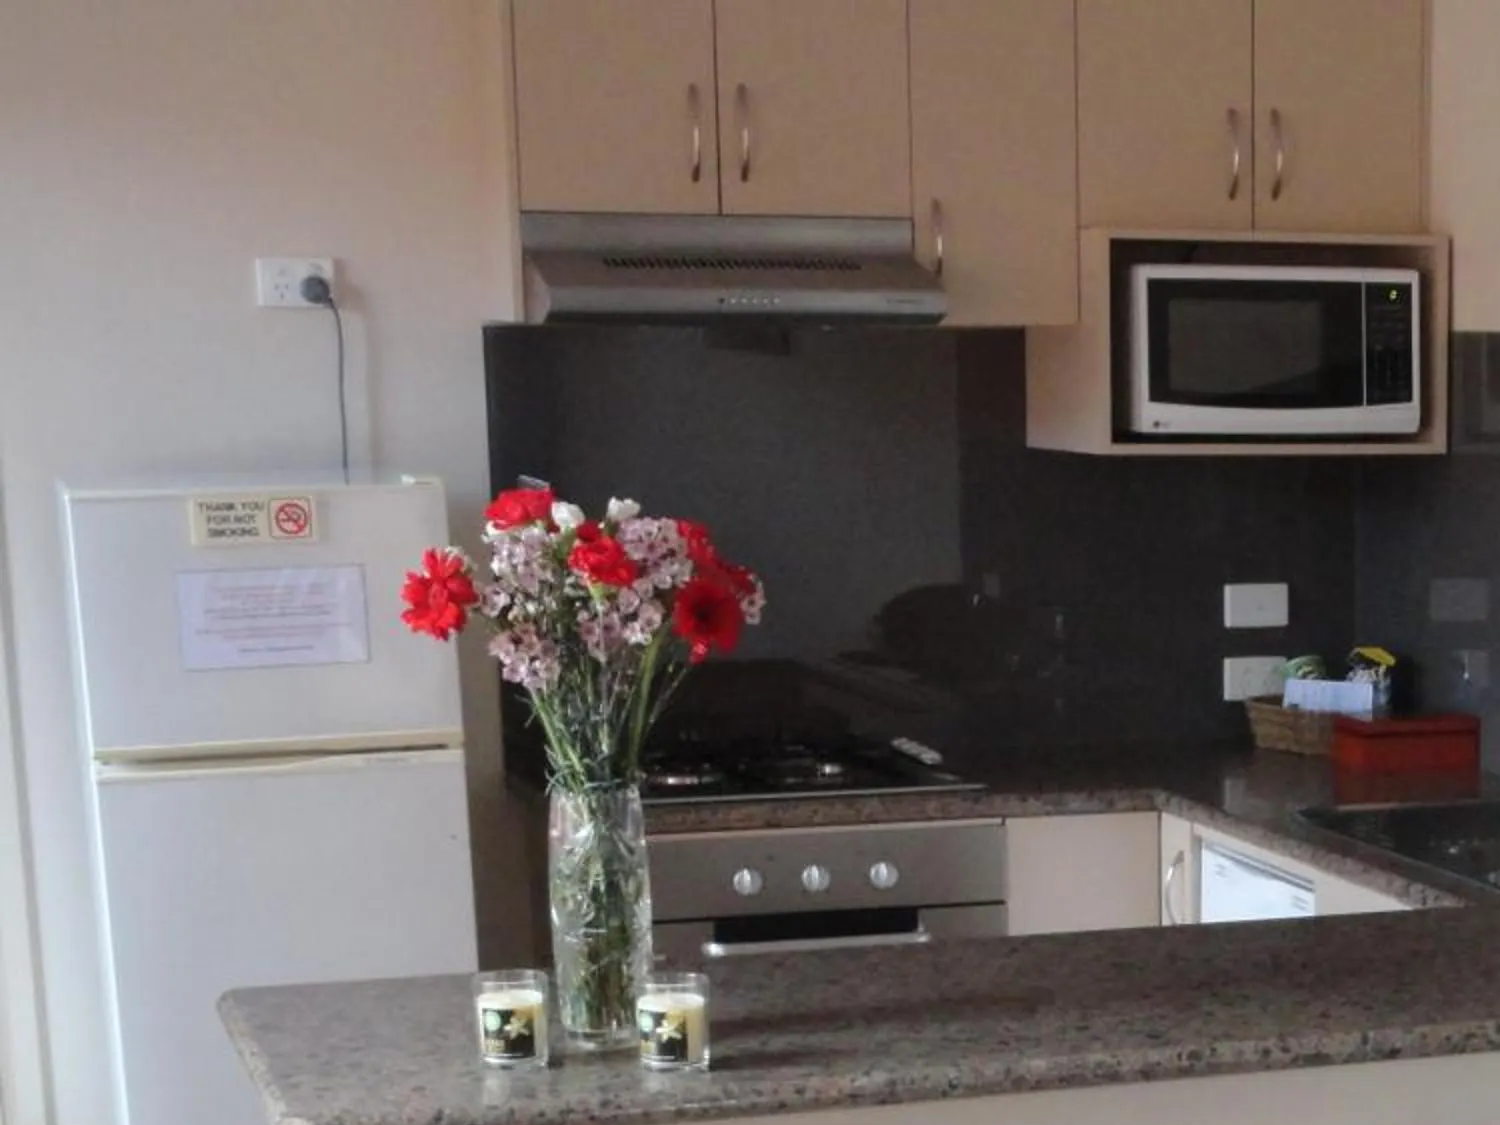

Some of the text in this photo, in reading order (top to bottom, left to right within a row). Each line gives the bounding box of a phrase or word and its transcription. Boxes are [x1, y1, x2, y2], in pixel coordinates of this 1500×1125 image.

[198, 501, 264, 512] THANK YOU
[207, 514, 256, 525] FOR NOT
[207, 527, 260, 537] SMOKING
